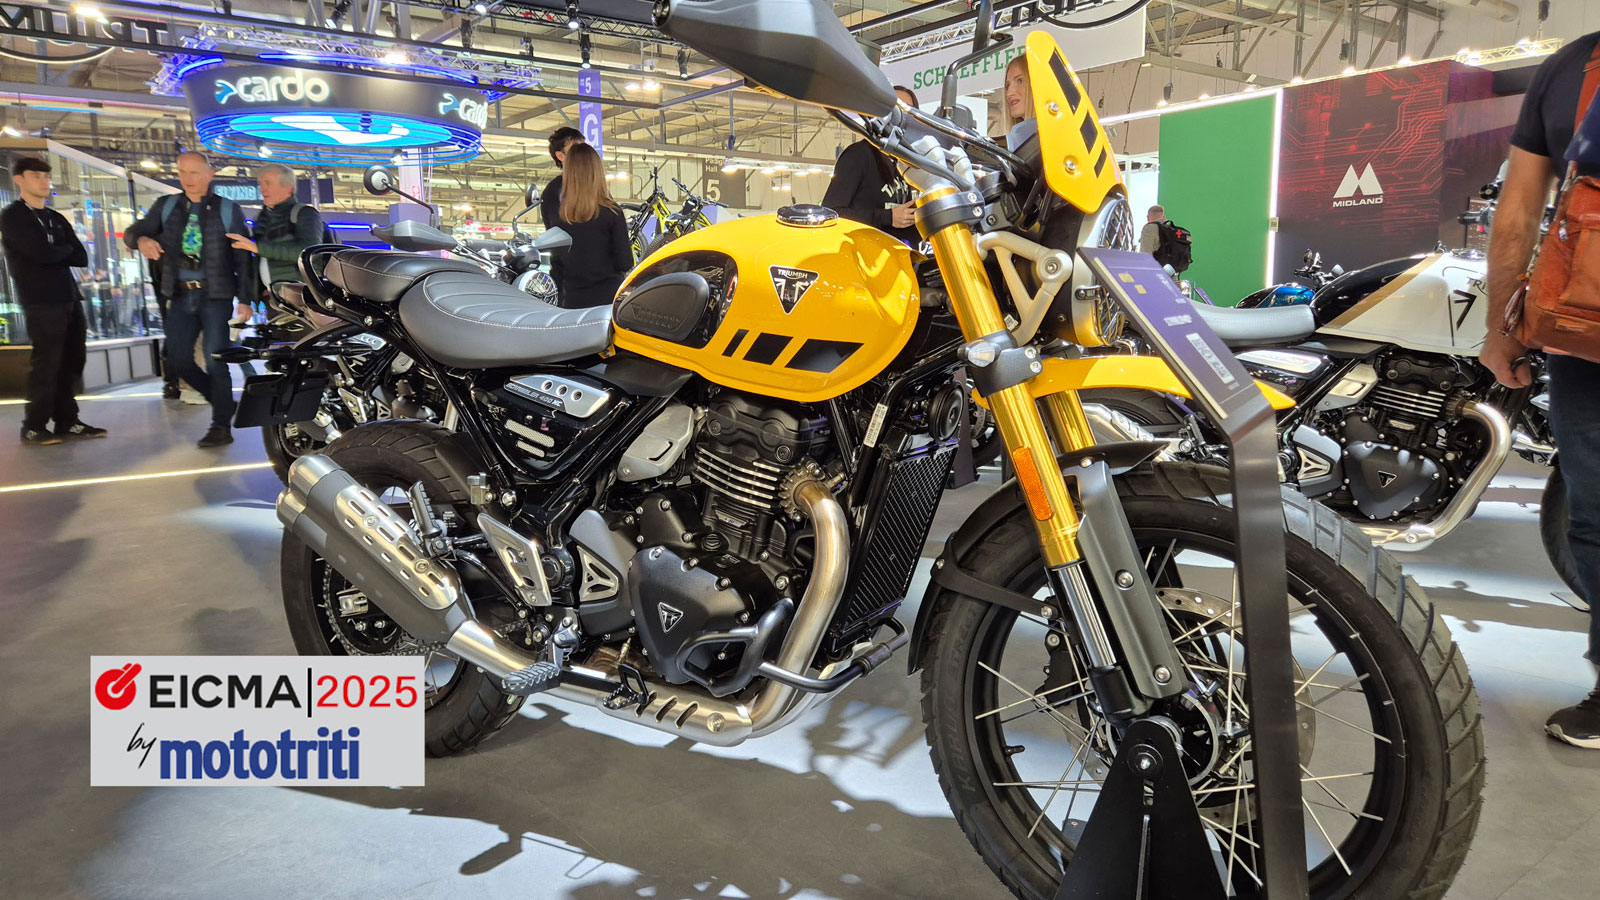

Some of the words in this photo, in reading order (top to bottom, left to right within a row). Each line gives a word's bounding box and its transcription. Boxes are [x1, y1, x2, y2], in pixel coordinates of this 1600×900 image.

[237, 71, 330, 103] cardo
[585, 76, 592, 94] 5
[583, 113, 599, 147] G
[706, 179, 721, 201] 5
[1332, 197, 1384, 208] MIDLAND
[777, 269, 808, 280] TRIUMPH
[539, 394, 553, 404] 400
[552, 398, 563, 407] XC
